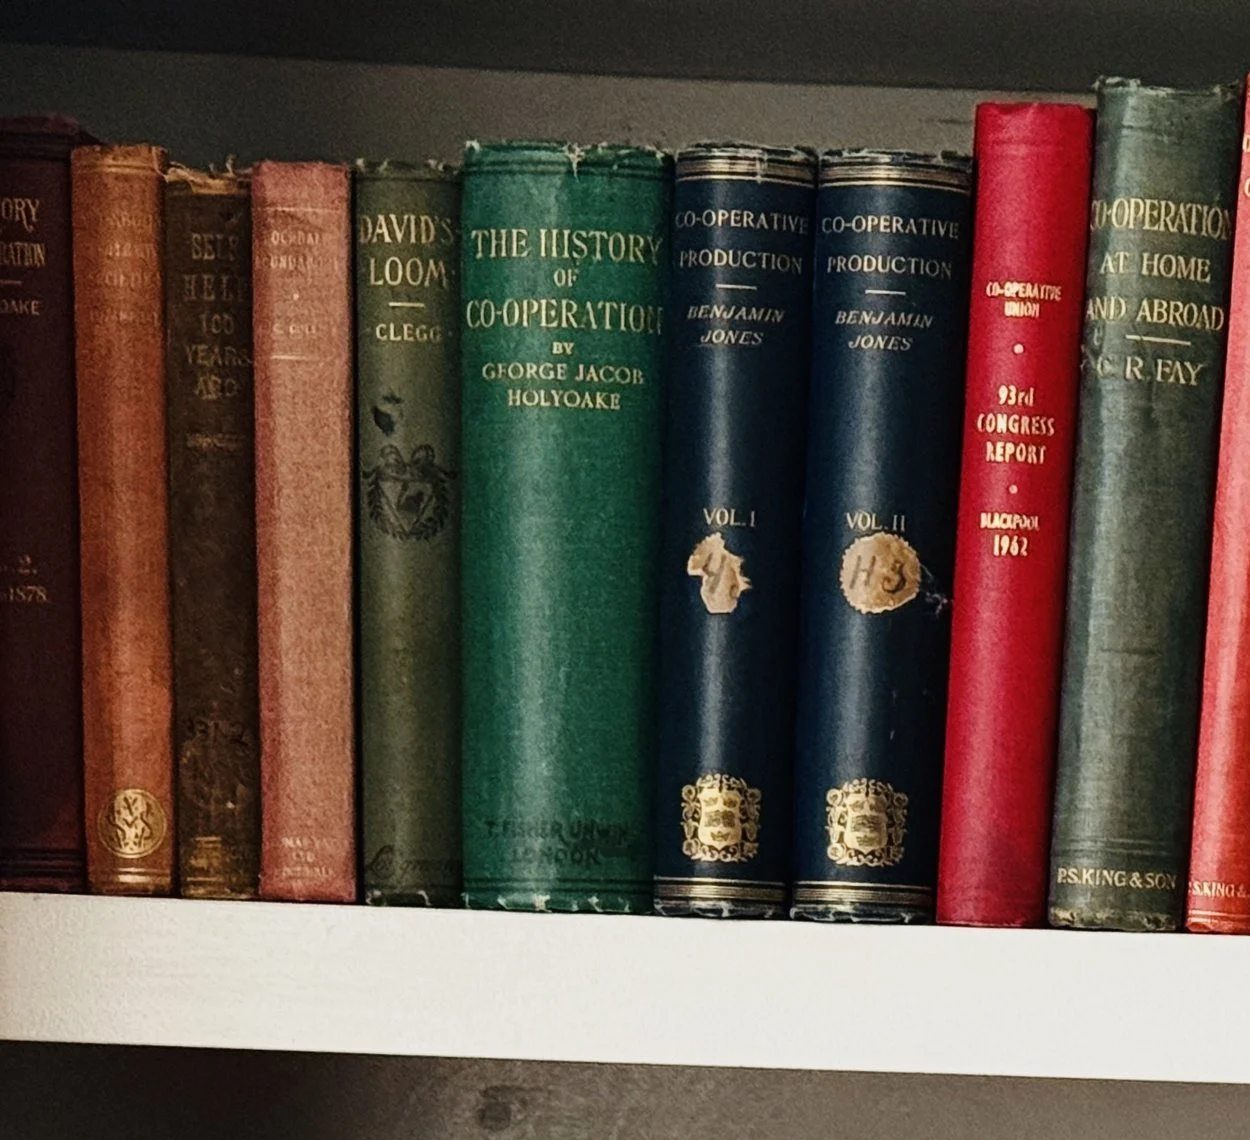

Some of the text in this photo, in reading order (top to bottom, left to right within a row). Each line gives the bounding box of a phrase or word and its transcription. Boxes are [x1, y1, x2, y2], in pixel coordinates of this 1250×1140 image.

[359, 213, 454, 245] DAVID'S
[821, 215, 959, 240] CO-OPERATIVE
[471, 228, 663, 264] THE HISTORY
[369, 256, 448, 288] LOOM
[680, 249, 802, 274] PRODUCTION
[827, 255, 952, 280] PRODUCTION
[1100, 251, 1211, 283] AT HOME
[553, 269, 578, 287] OF
[986, 281, 1062, 301] CO-OPERATIVE
[466, 299, 664, 335] CO-OPERATION
[687, 305, 785, 323] BENJAMIN
[835, 310, 934, 328] BENJAMIN
[1136, 298, 1224, 330] ABROAD
[375, 323, 442, 343] CLEGG
[700, 328, 764, 345] JONES
[848, 335, 913, 351] JONES
[552, 341, 575, 354] BY
[482, 362, 645, 385] GEORGE JACOB
[507, 388, 621, 410] HOLYOAKE
[998, 385, 1034, 406] 93rd
[977, 413, 1055, 436] CONGRESS
[986, 441, 1046, 464] REPORT
[980, 512, 1039, 531] BLACKPOOL
[993, 534, 1028, 557] 1962
